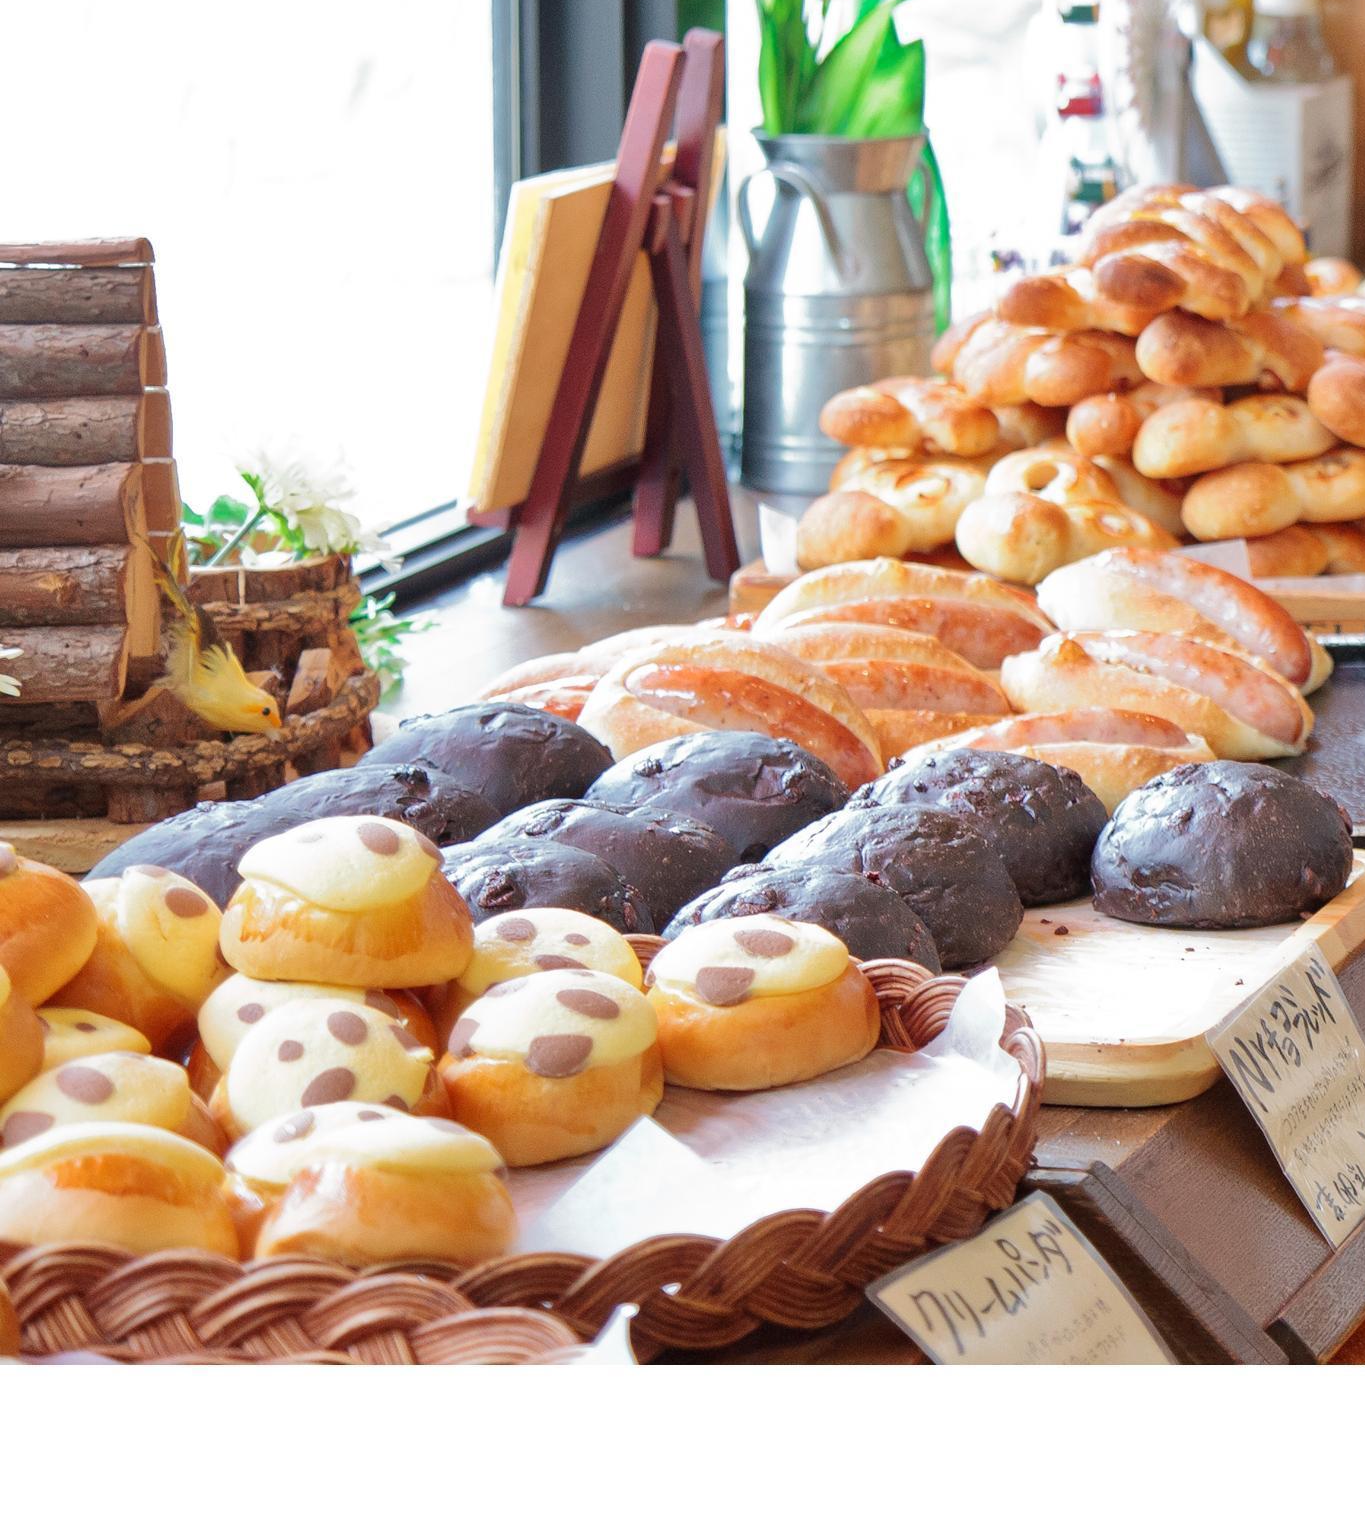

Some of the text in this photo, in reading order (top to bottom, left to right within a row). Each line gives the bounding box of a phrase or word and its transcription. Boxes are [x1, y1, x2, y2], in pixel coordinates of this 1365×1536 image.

[908, 1218, 1074, 1356] クリームパンダ
